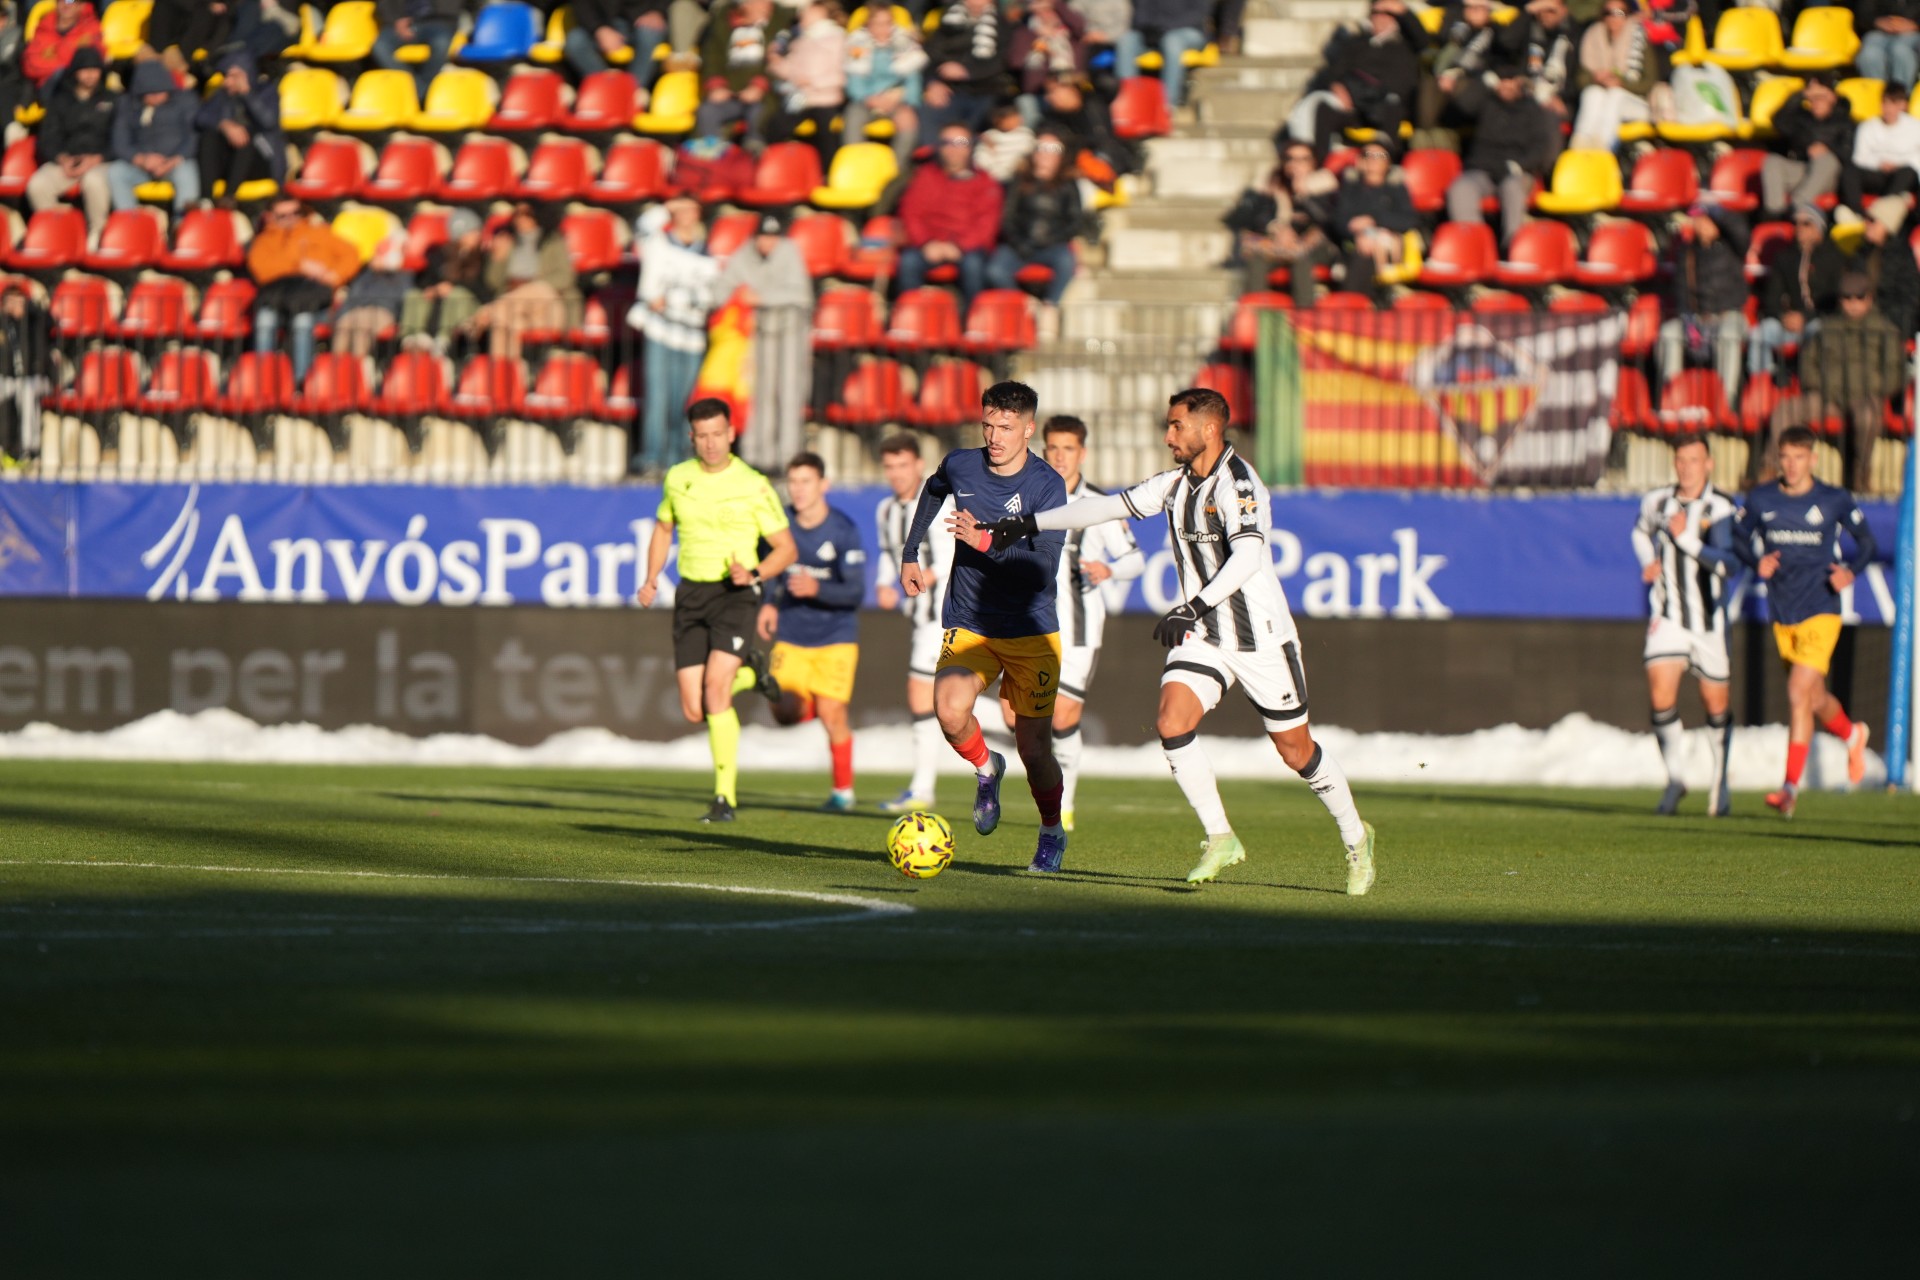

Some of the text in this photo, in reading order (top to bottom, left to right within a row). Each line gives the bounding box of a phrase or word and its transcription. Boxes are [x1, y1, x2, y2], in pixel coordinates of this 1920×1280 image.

[191, 513, 677, 608] AnvósPark
[0, 646, 133, 713] em
[170, 647, 347, 717] per
[376, 628, 459, 719] la
